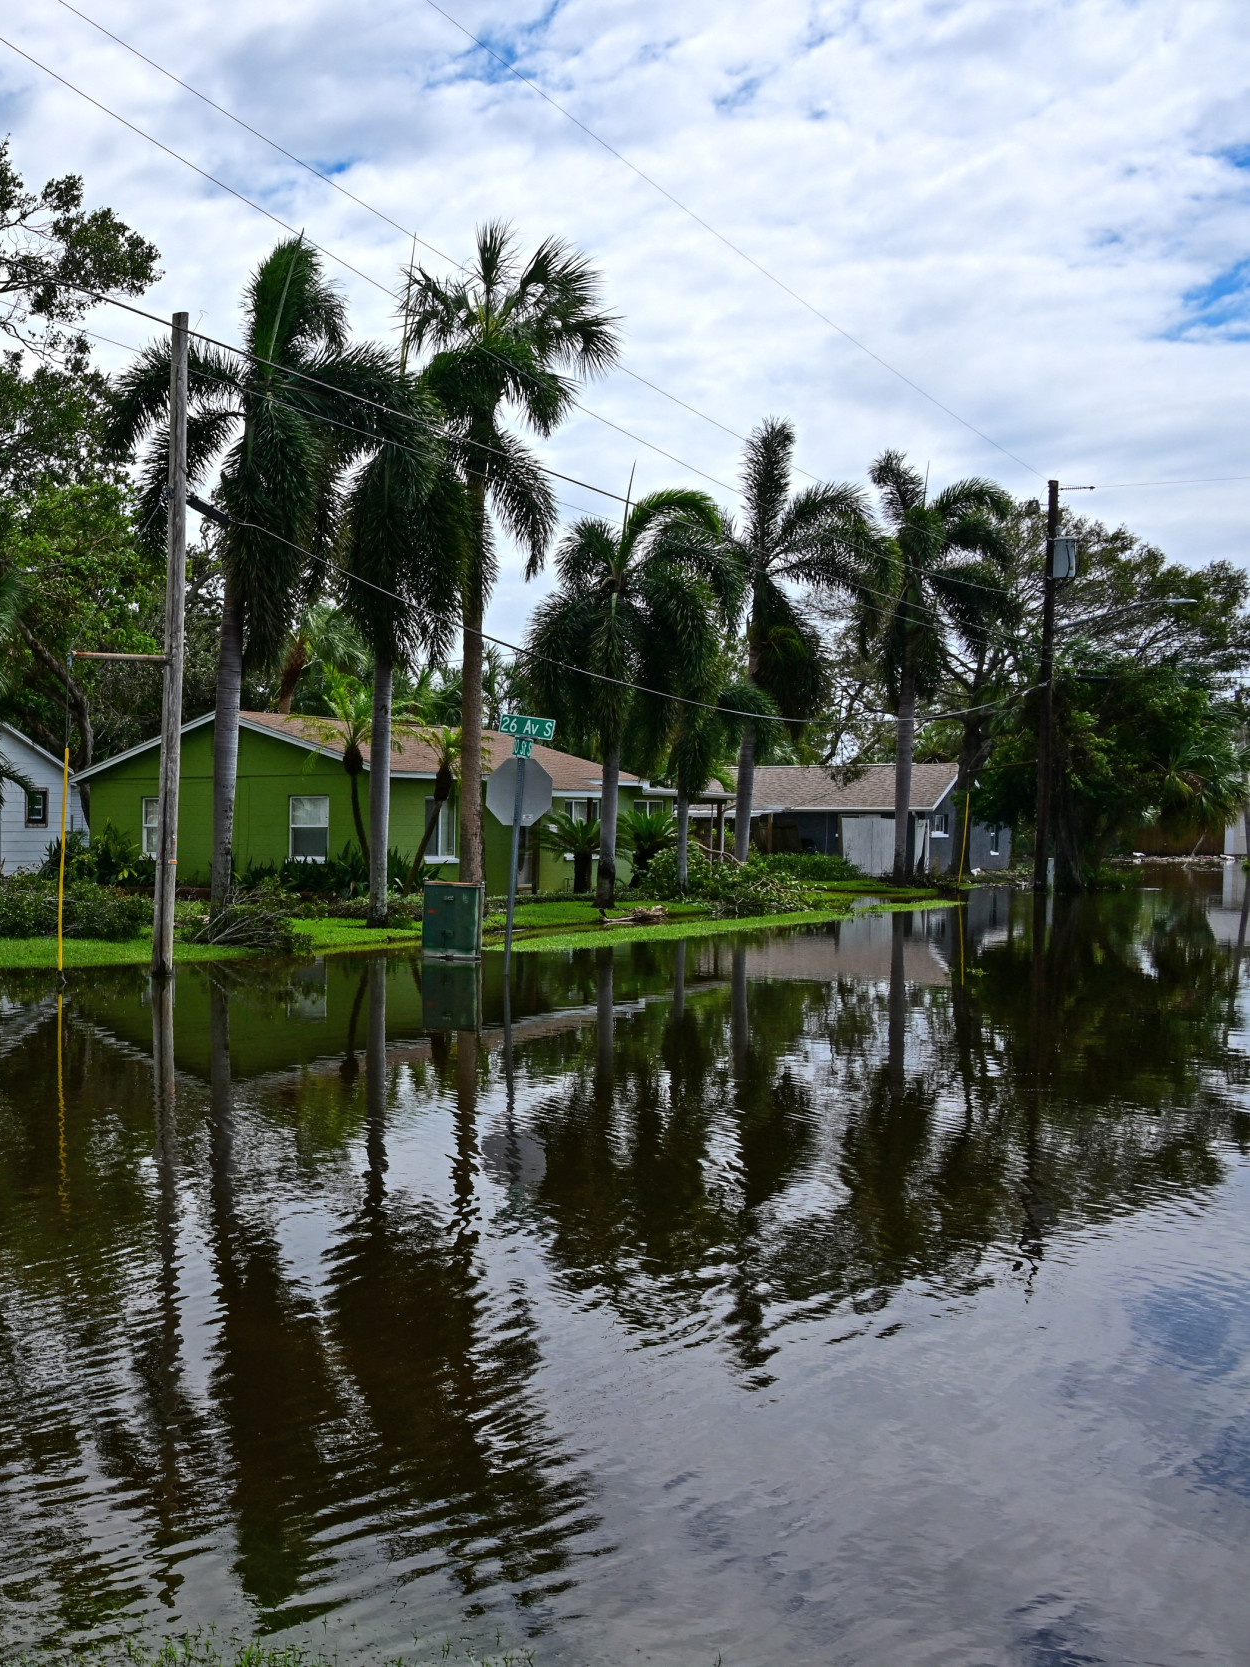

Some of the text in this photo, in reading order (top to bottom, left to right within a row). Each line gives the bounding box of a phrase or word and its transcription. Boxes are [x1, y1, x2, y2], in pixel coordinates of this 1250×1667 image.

[501, 717, 552, 736] 26 Av S
